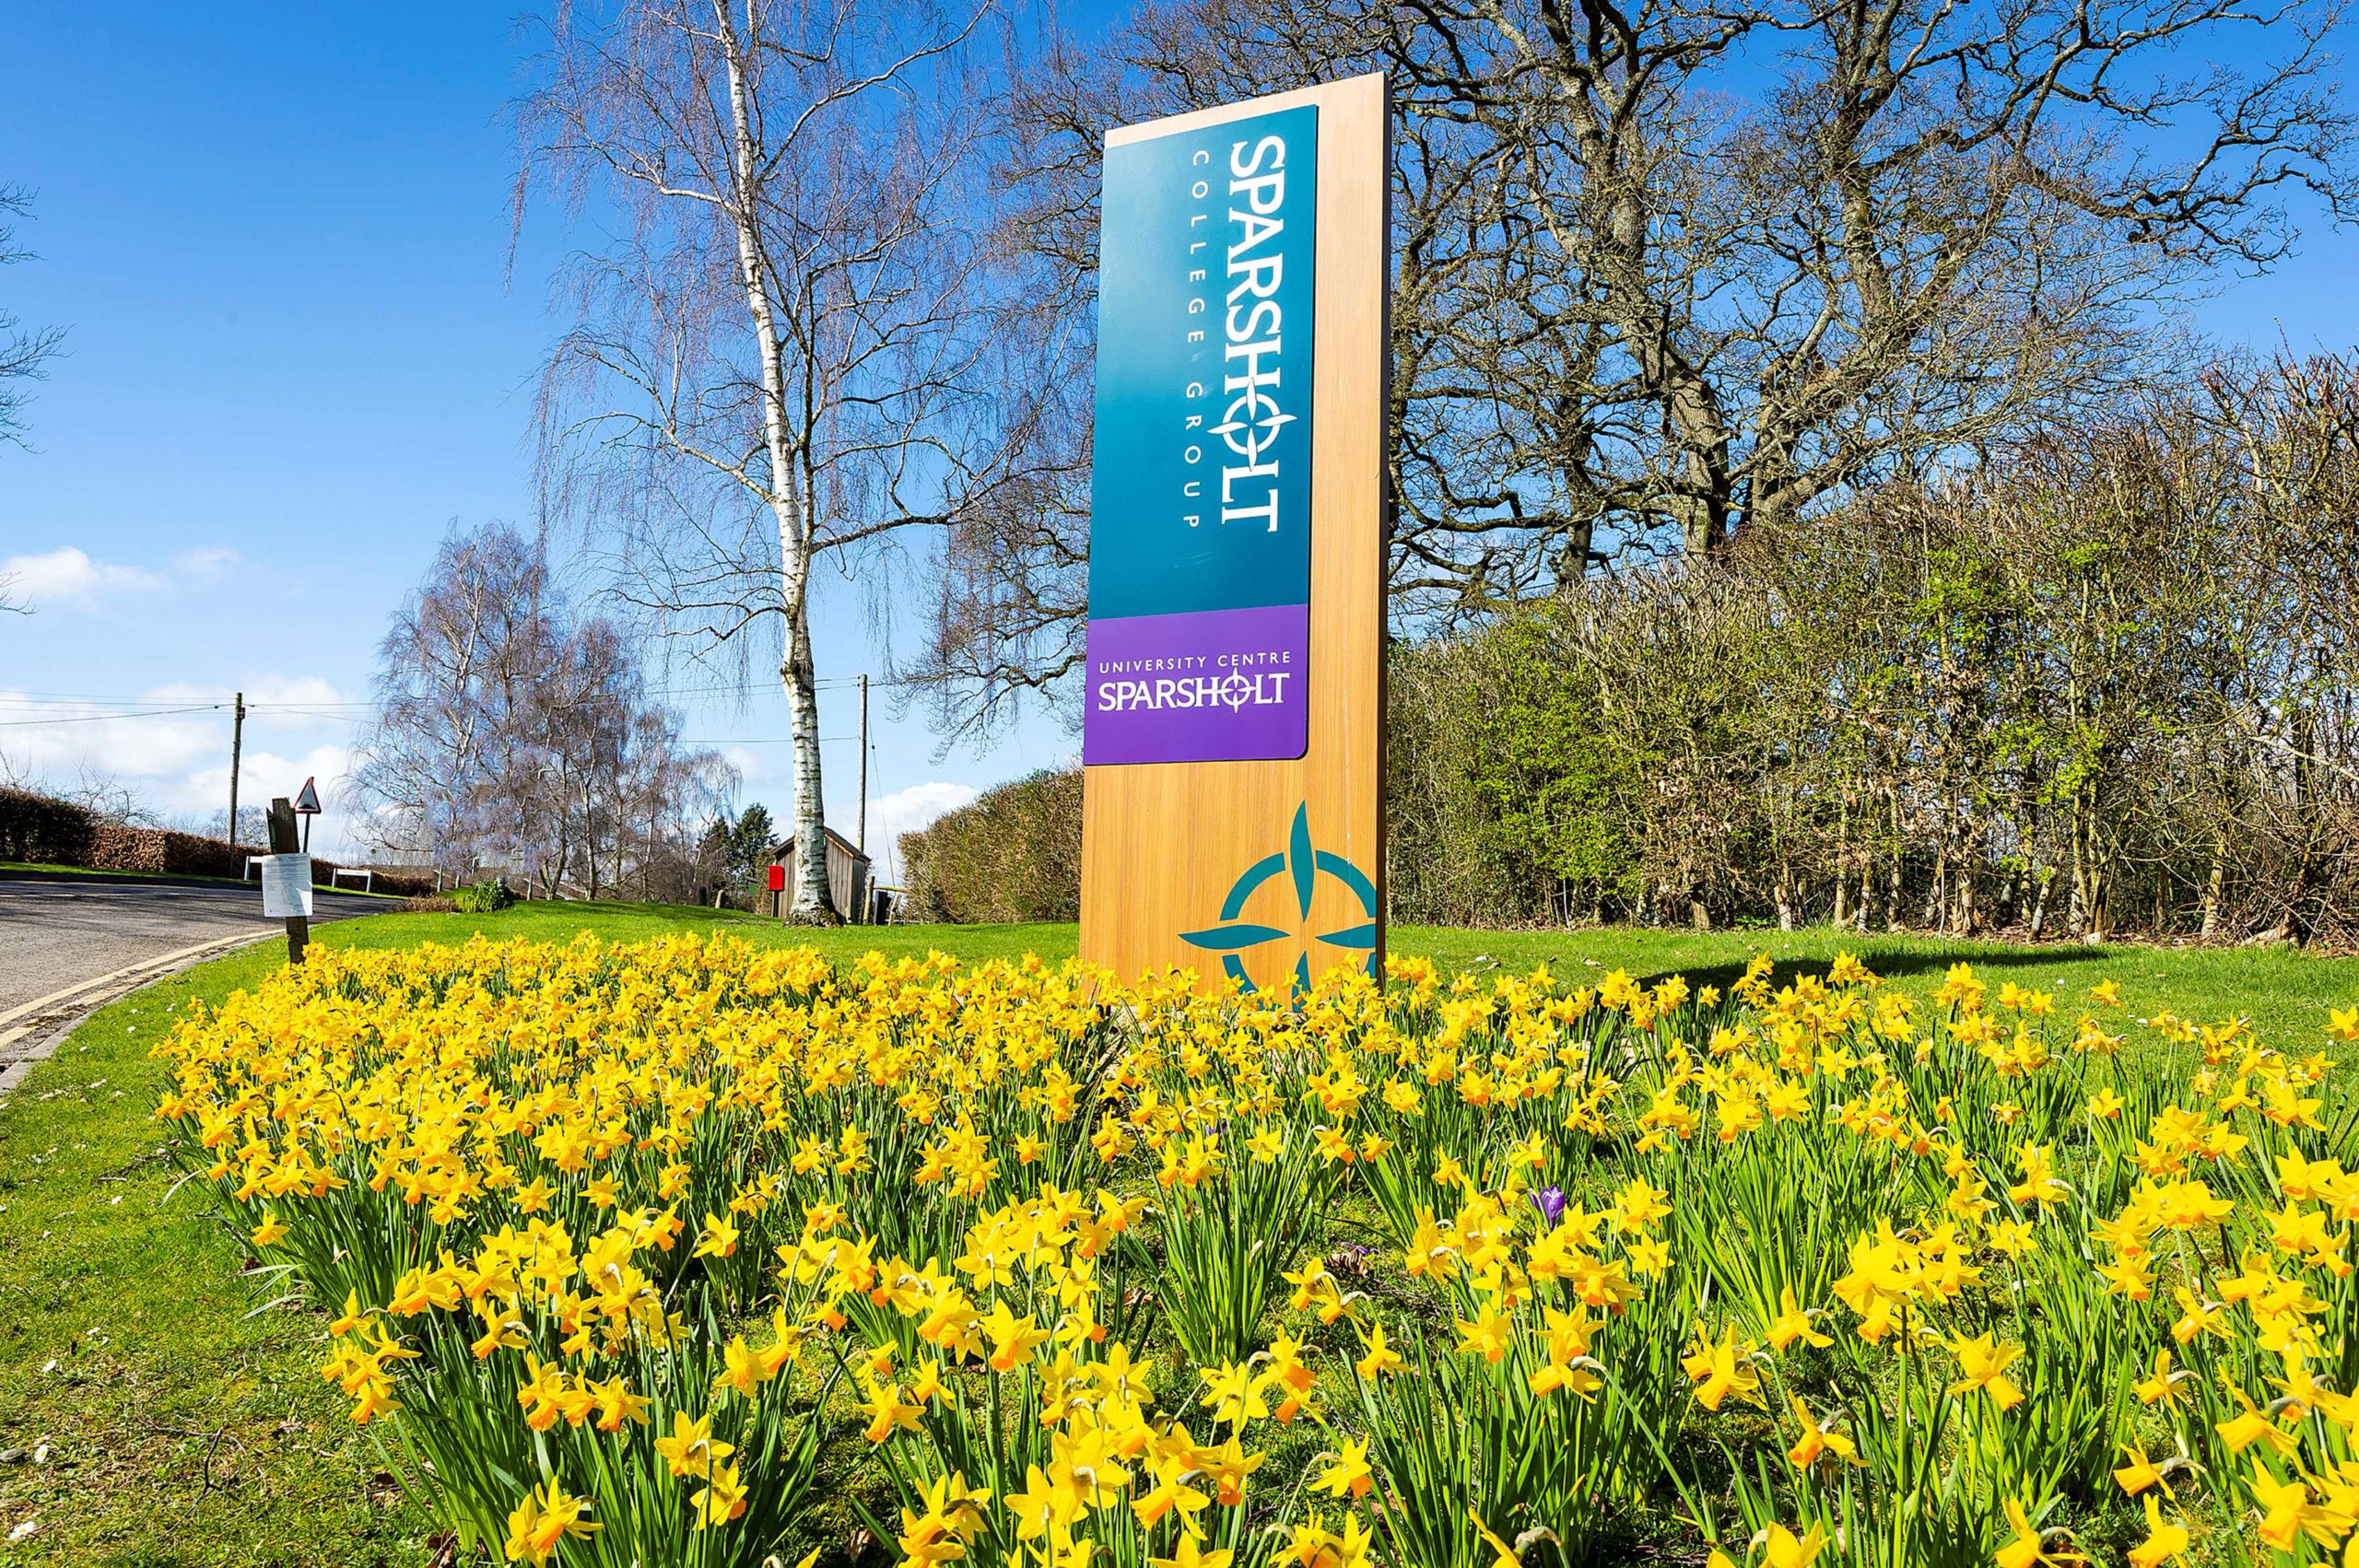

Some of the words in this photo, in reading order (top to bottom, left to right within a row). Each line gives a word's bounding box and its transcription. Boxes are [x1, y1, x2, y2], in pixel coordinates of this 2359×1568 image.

[1187, 149, 1210, 344] COLLEGE
[1208, 135, 1297, 532] SPARSHOLT
[1182, 380, 1204, 529] GROUP
[1097, 667, 1291, 713] SPARSHOLT
[1098, 656, 1207, 674] UNIVERSITY
[1216, 650, 1291, 668] CENTRE
